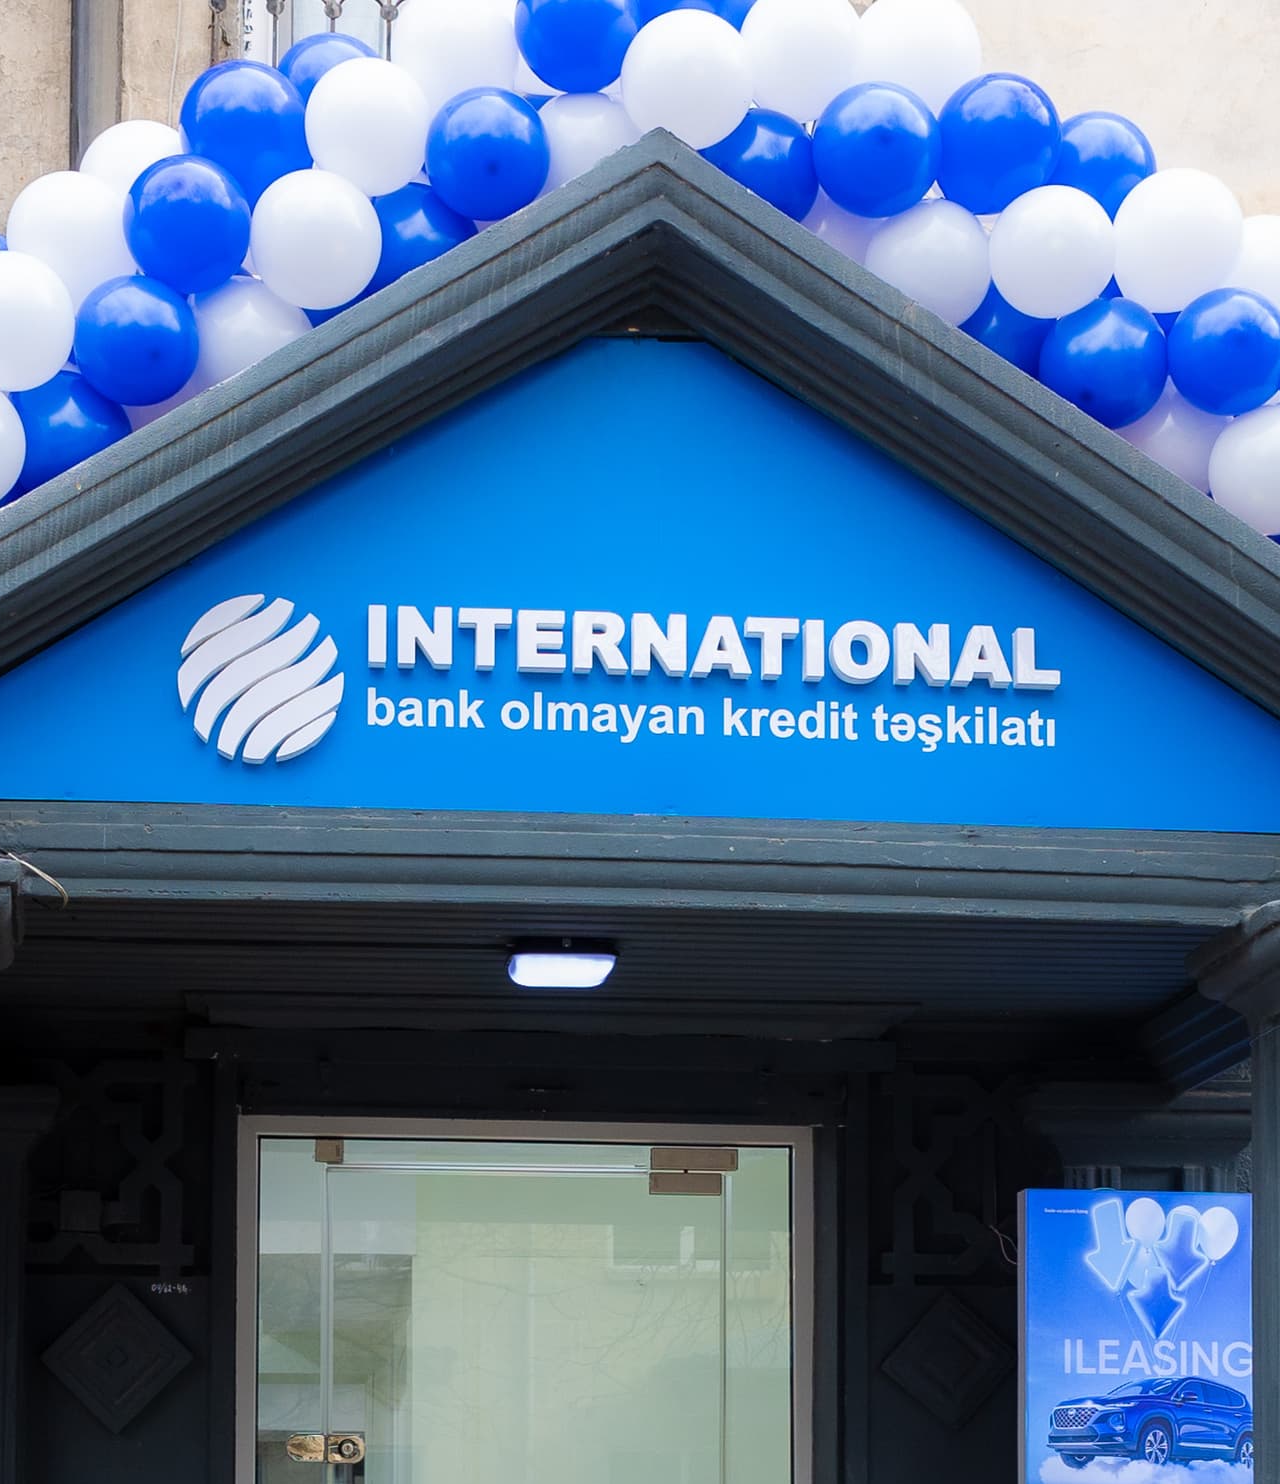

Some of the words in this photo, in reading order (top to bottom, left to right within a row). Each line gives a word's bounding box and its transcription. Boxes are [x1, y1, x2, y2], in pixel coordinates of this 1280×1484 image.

[368, 604, 1062, 692] INTERNATIONAL
[368, 687, 484, 729] bank
[501, 691, 705, 743] olmayan
[724, 699, 858, 741] kredit
[872, 704, 1057, 753] təşkilatı
[1064, 1338, 1254, 1378] ILEASING
